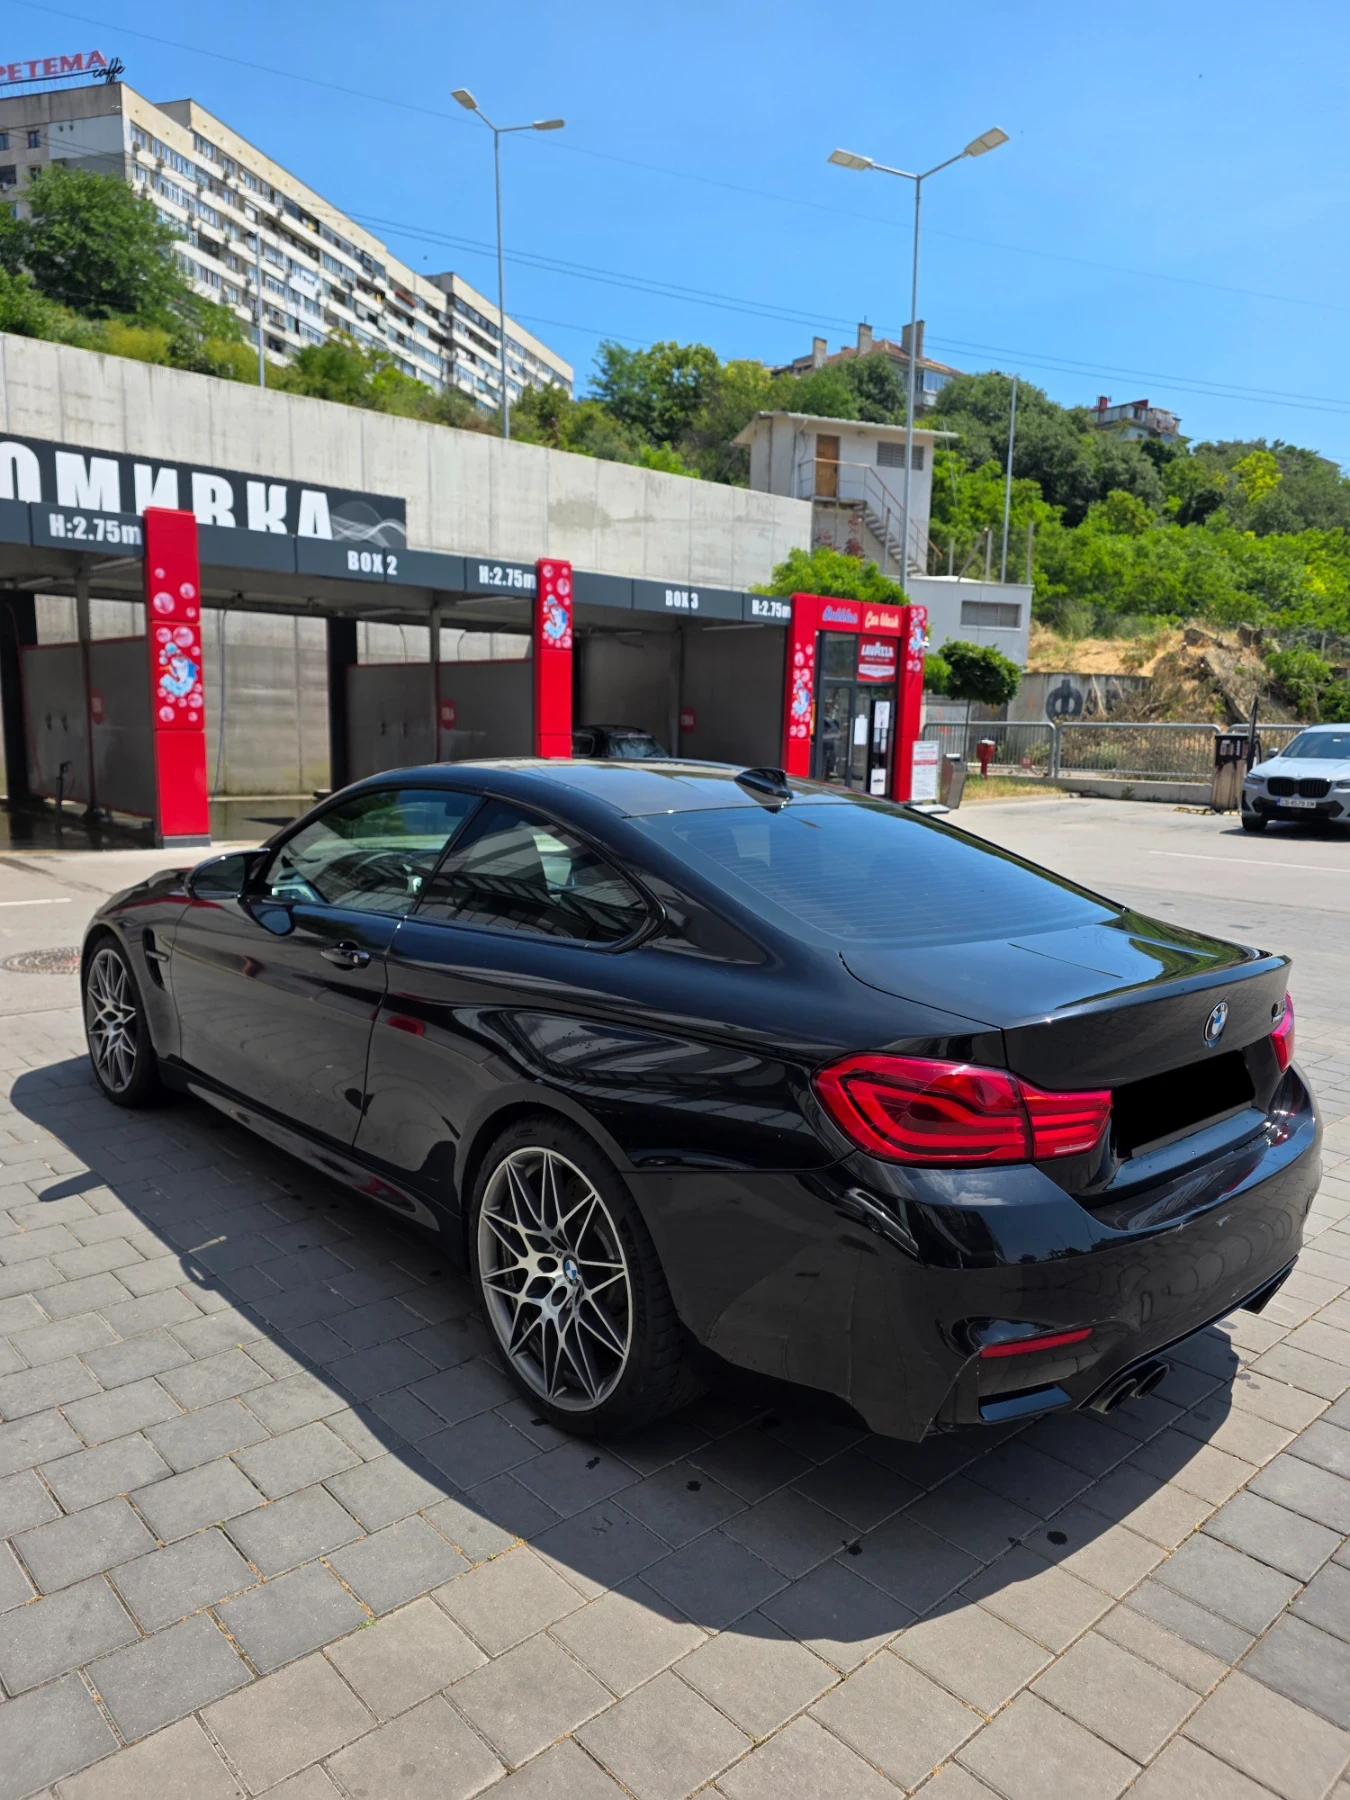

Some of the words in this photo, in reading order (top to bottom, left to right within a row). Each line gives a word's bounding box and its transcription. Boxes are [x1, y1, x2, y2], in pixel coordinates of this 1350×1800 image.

[48, 513, 143, 546] H:2.75m
[347, 550, 384, 573] BOX
[386, 555, 398, 576] 2
[478, 565, 537, 590] H:2.75m
[665, 589, 690, 609] BOX
[690, 592, 699, 610] 3
[751, 599, 791, 619] H:2.75m
[864, 610, 879, 629] Car
